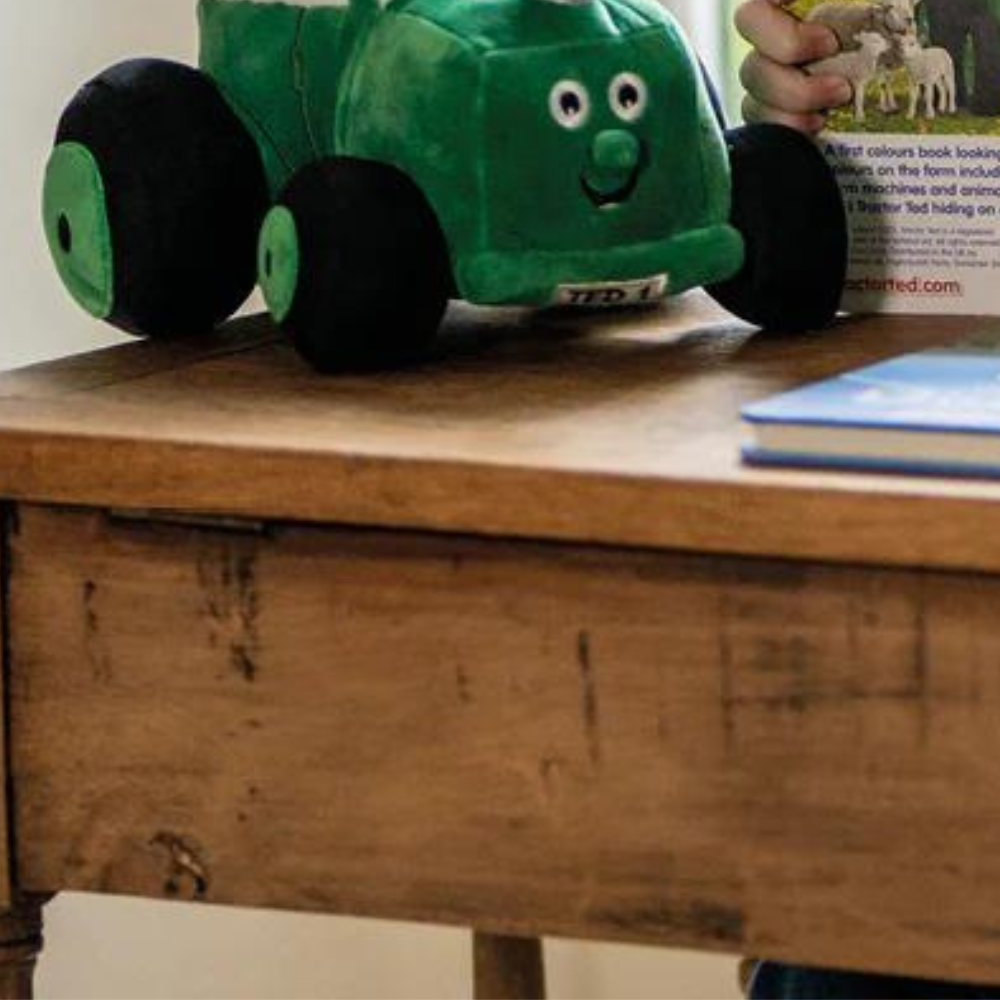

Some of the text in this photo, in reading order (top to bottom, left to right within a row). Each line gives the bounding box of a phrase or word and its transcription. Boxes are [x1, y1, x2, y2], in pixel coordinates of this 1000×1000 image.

[838, 144, 863, 157] first
[867, 145, 914, 158] colours
[919, 146, 952, 158] book
[878, 166, 894, 177] on
[899, 165, 919, 178] the
[924, 164, 956, 178] farm
[863, 183, 926, 196] machines
[930, 184, 957, 196] and
[931, 203, 974, 218] hiding
[977, 206, 995, 216] on
